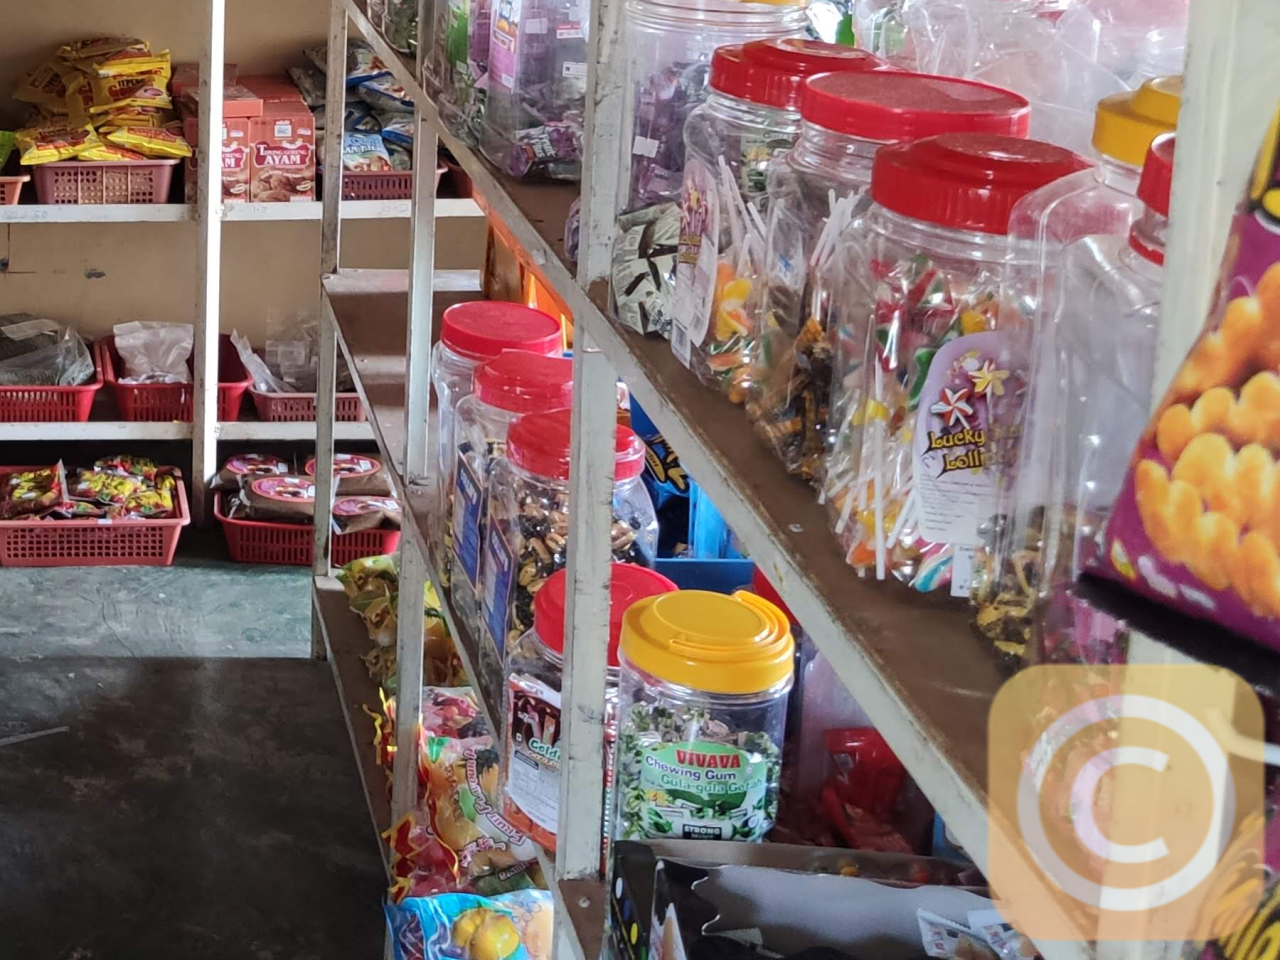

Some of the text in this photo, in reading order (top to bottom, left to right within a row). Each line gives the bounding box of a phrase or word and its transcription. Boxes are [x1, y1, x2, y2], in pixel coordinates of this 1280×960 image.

[264, 155, 301, 164] AYAM
[926, 428, 986, 450] Lucky
[645, 755, 737, 781] Chewing Gum
[661, 774, 763, 794] Gula-gula Getah
[683, 825, 721, 835] STRONG
